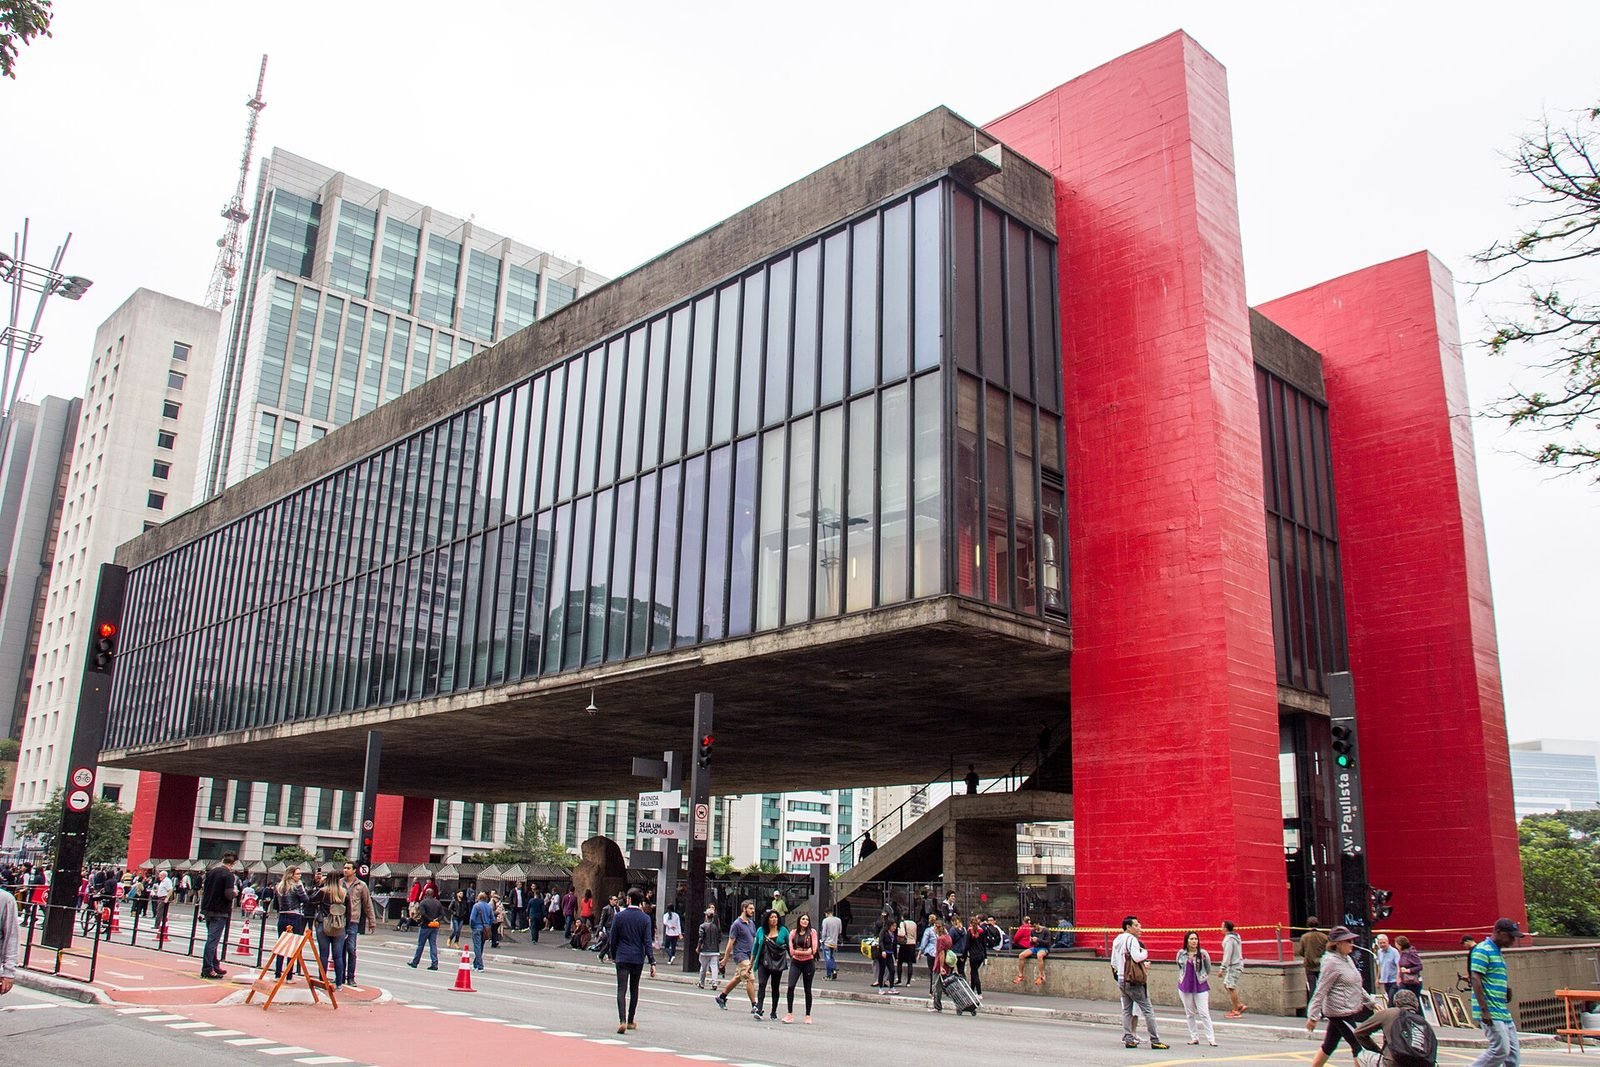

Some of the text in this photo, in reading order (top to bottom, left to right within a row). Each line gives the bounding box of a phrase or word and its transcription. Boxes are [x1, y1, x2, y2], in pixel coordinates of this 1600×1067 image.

[1338, 773, 1355, 857] Av. Paulista
[793, 847, 830, 862] MASP
